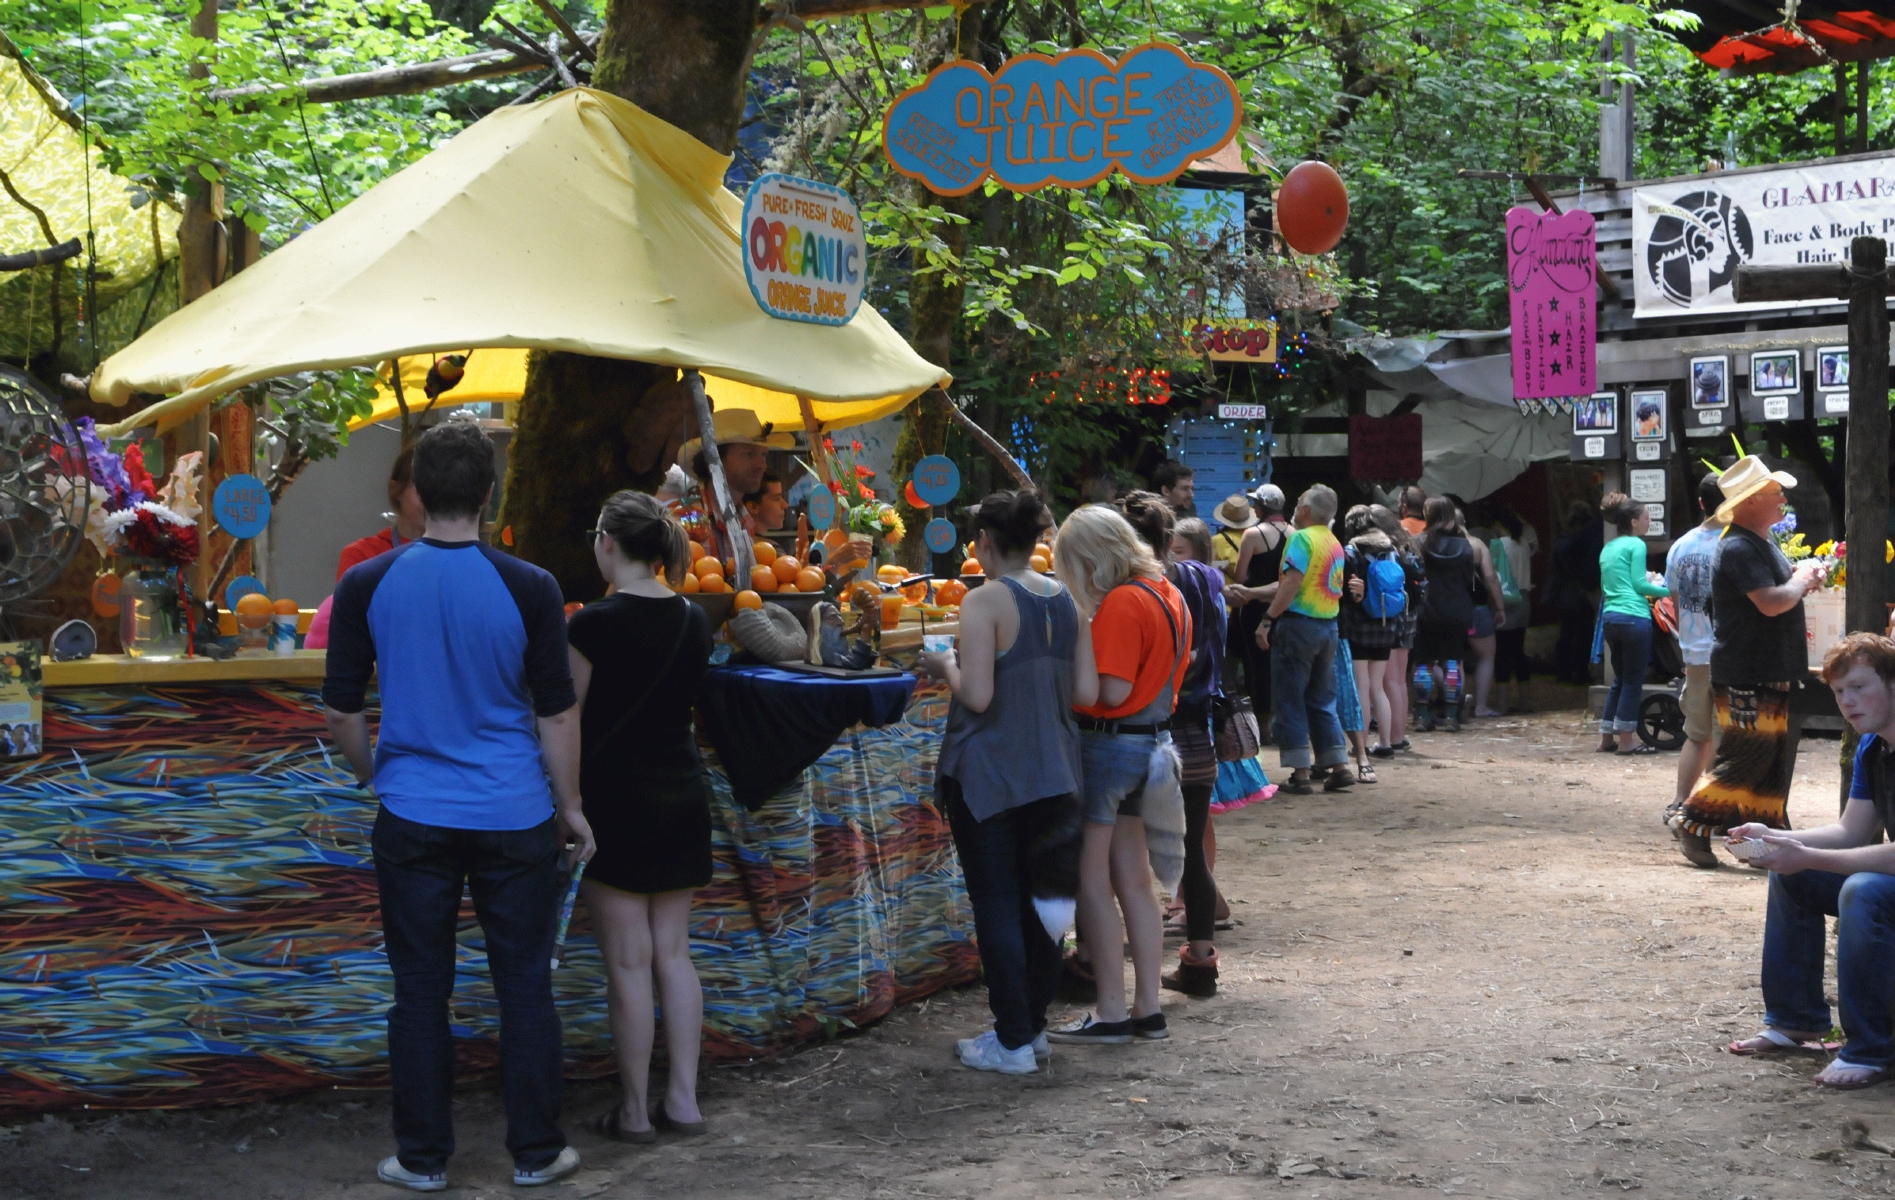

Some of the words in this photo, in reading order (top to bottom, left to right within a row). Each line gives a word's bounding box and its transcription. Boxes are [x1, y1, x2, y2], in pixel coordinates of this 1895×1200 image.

[955, 72, 1153, 128] ORANGE
[1146, 81, 1226, 141] RIPENED
[1153, 71, 1203, 110] TREE
[907, 111, 958, 152] FRESH
[968, 117, 1133, 168] JUICE
[1141, 110, 1220, 169] ORGANIC
[893, 128, 971, 184] SQUEEZED
[762, 193, 788, 215] PURE
[795, 199, 827, 223] FRESH
[831, 207, 855, 233] SQUZ
[1763, 228, 1803, 245] Face
[1809, 224, 1823, 241] &
[1830, 220, 1876, 238] Body
[750, 216, 859, 285] ORGANIC
[1797, 247, 1837, 264] Hair
[767, 279, 812, 314] ORANGE
[814, 287, 847, 318] JUICE
[1522, 299, 1530, 339] FACE
[1537, 303, 1546, 391] PAINTING
[1564, 311, 1574, 370] HAIR
[1578, 296, 1587, 388] BRAIDING
[1223, 406, 1265, 418] ORDER
[225, 488, 266, 505] LARGE
